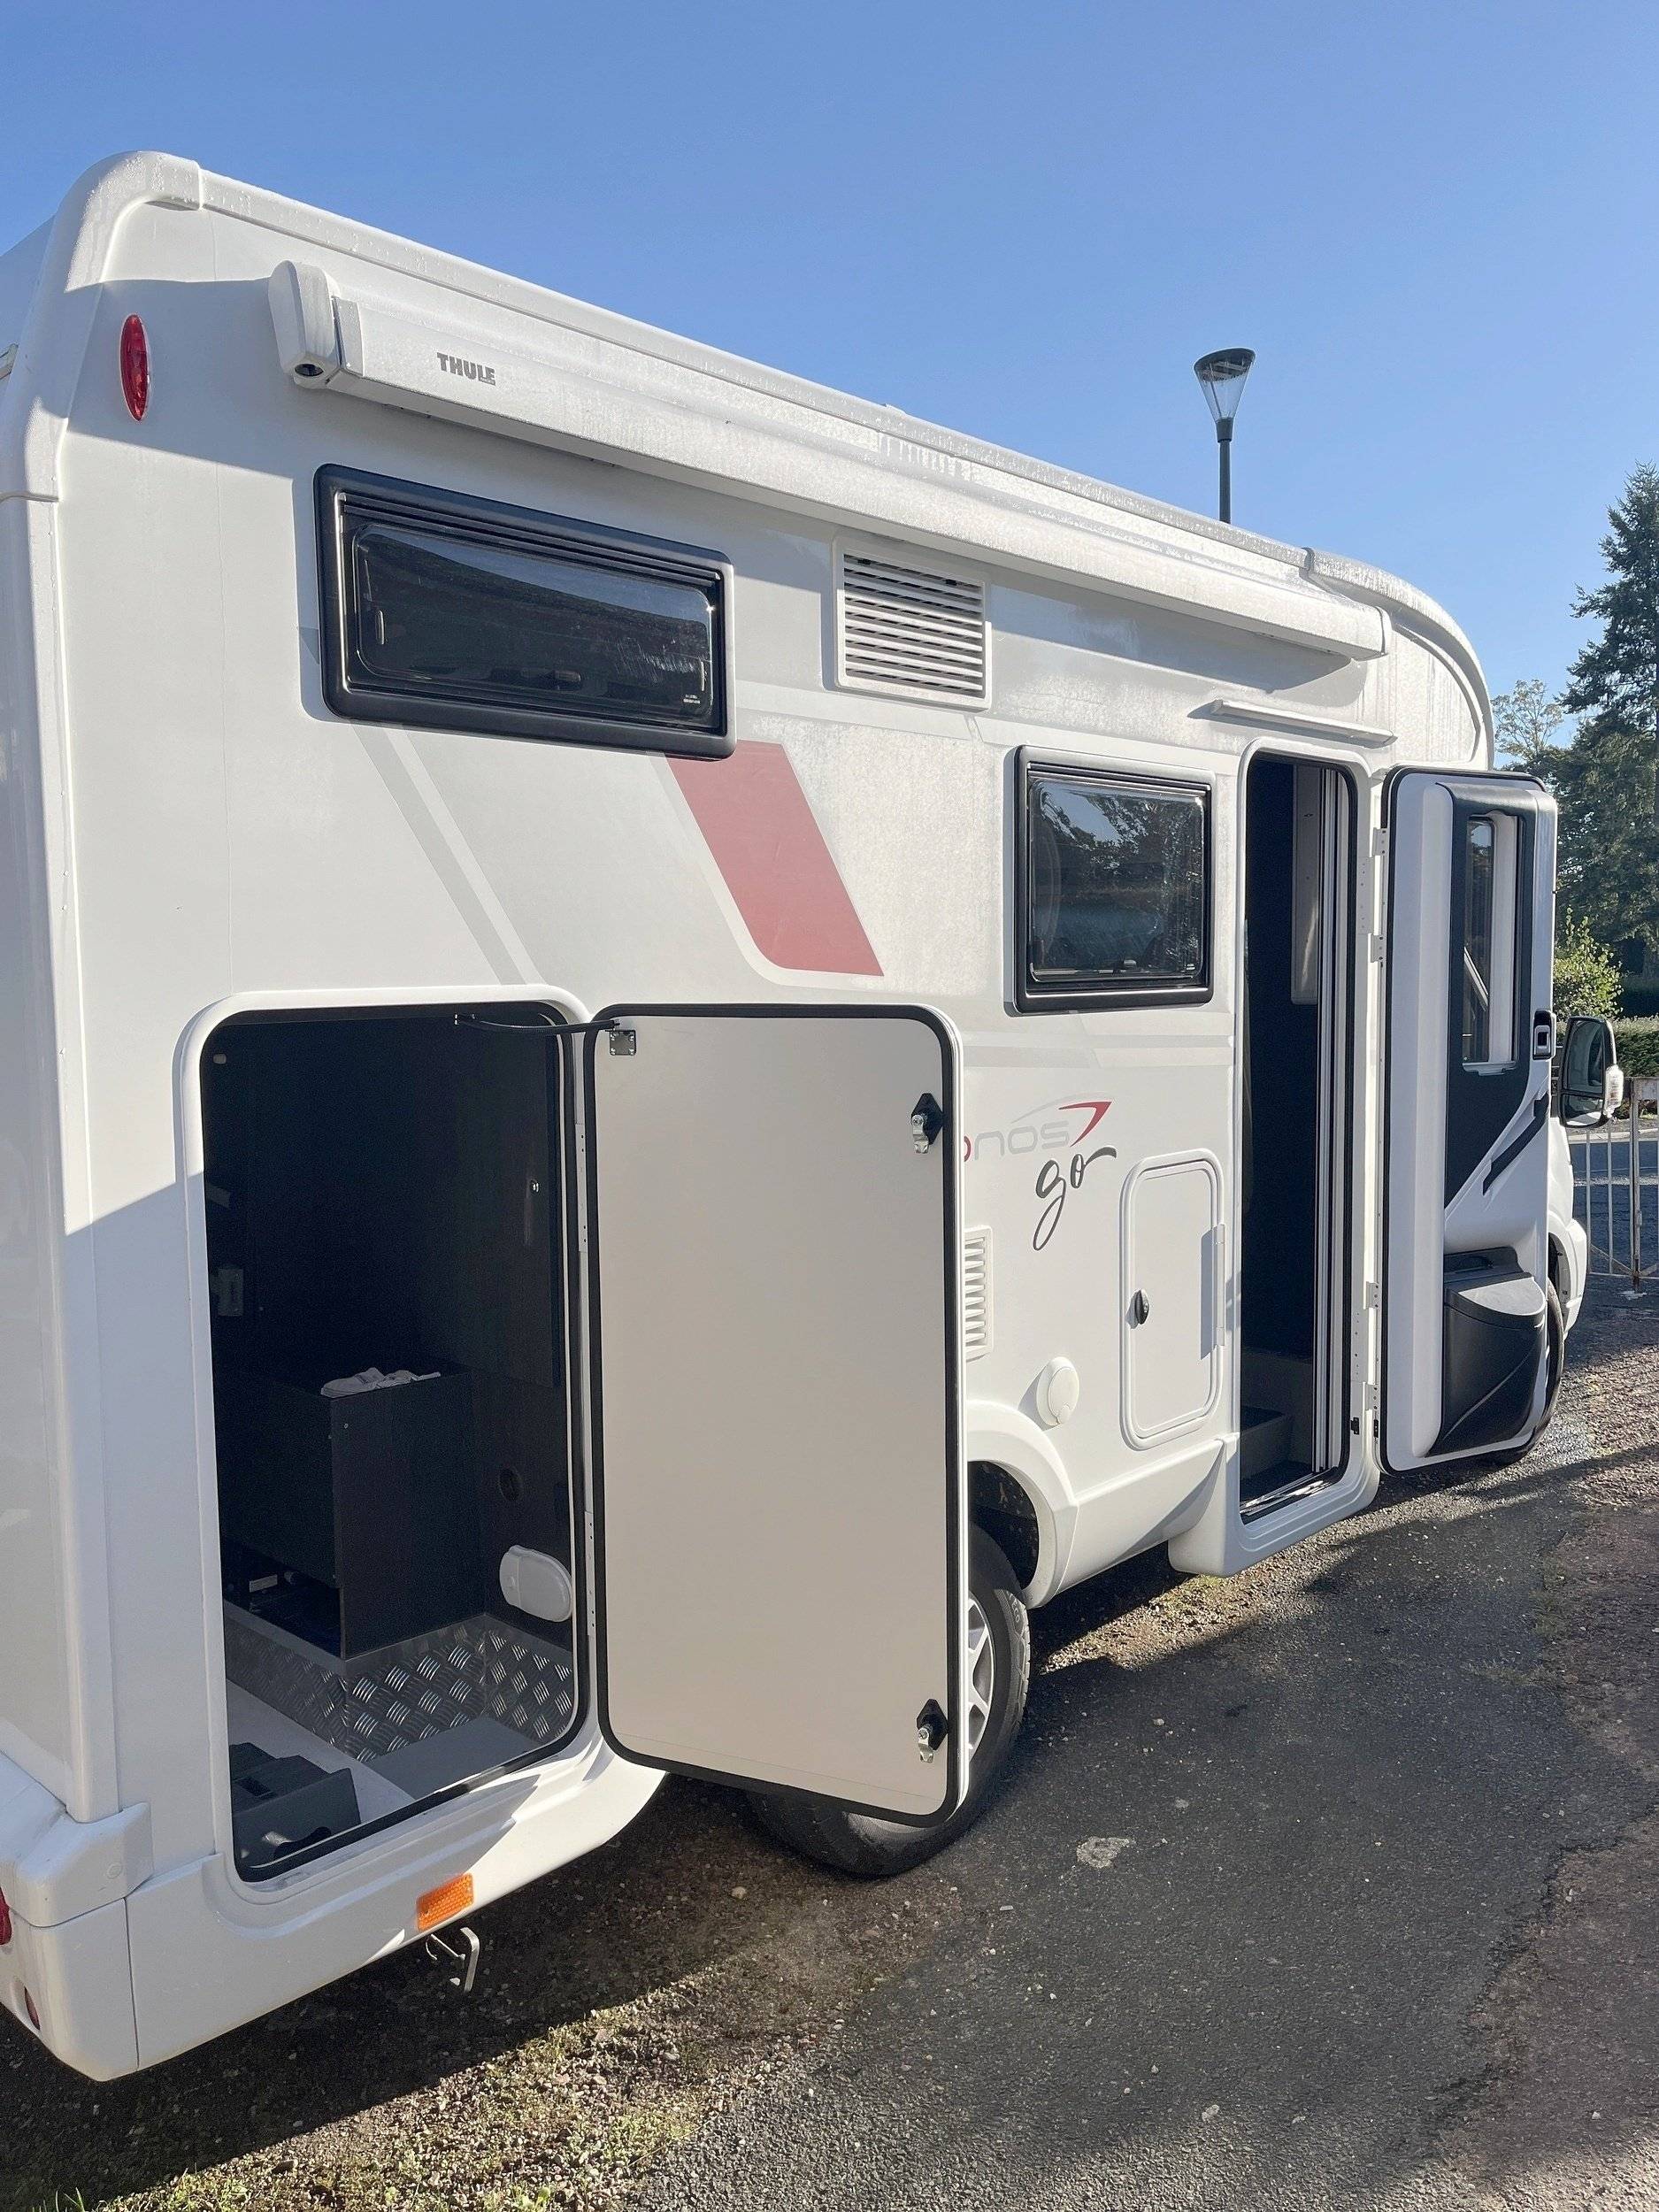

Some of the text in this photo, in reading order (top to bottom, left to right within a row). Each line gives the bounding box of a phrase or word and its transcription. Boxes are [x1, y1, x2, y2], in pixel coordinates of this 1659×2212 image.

[436, 352, 495, 384] THULE
[964, 1120, 1070, 1162] nos
[1033, 1145, 1117, 1251] go
